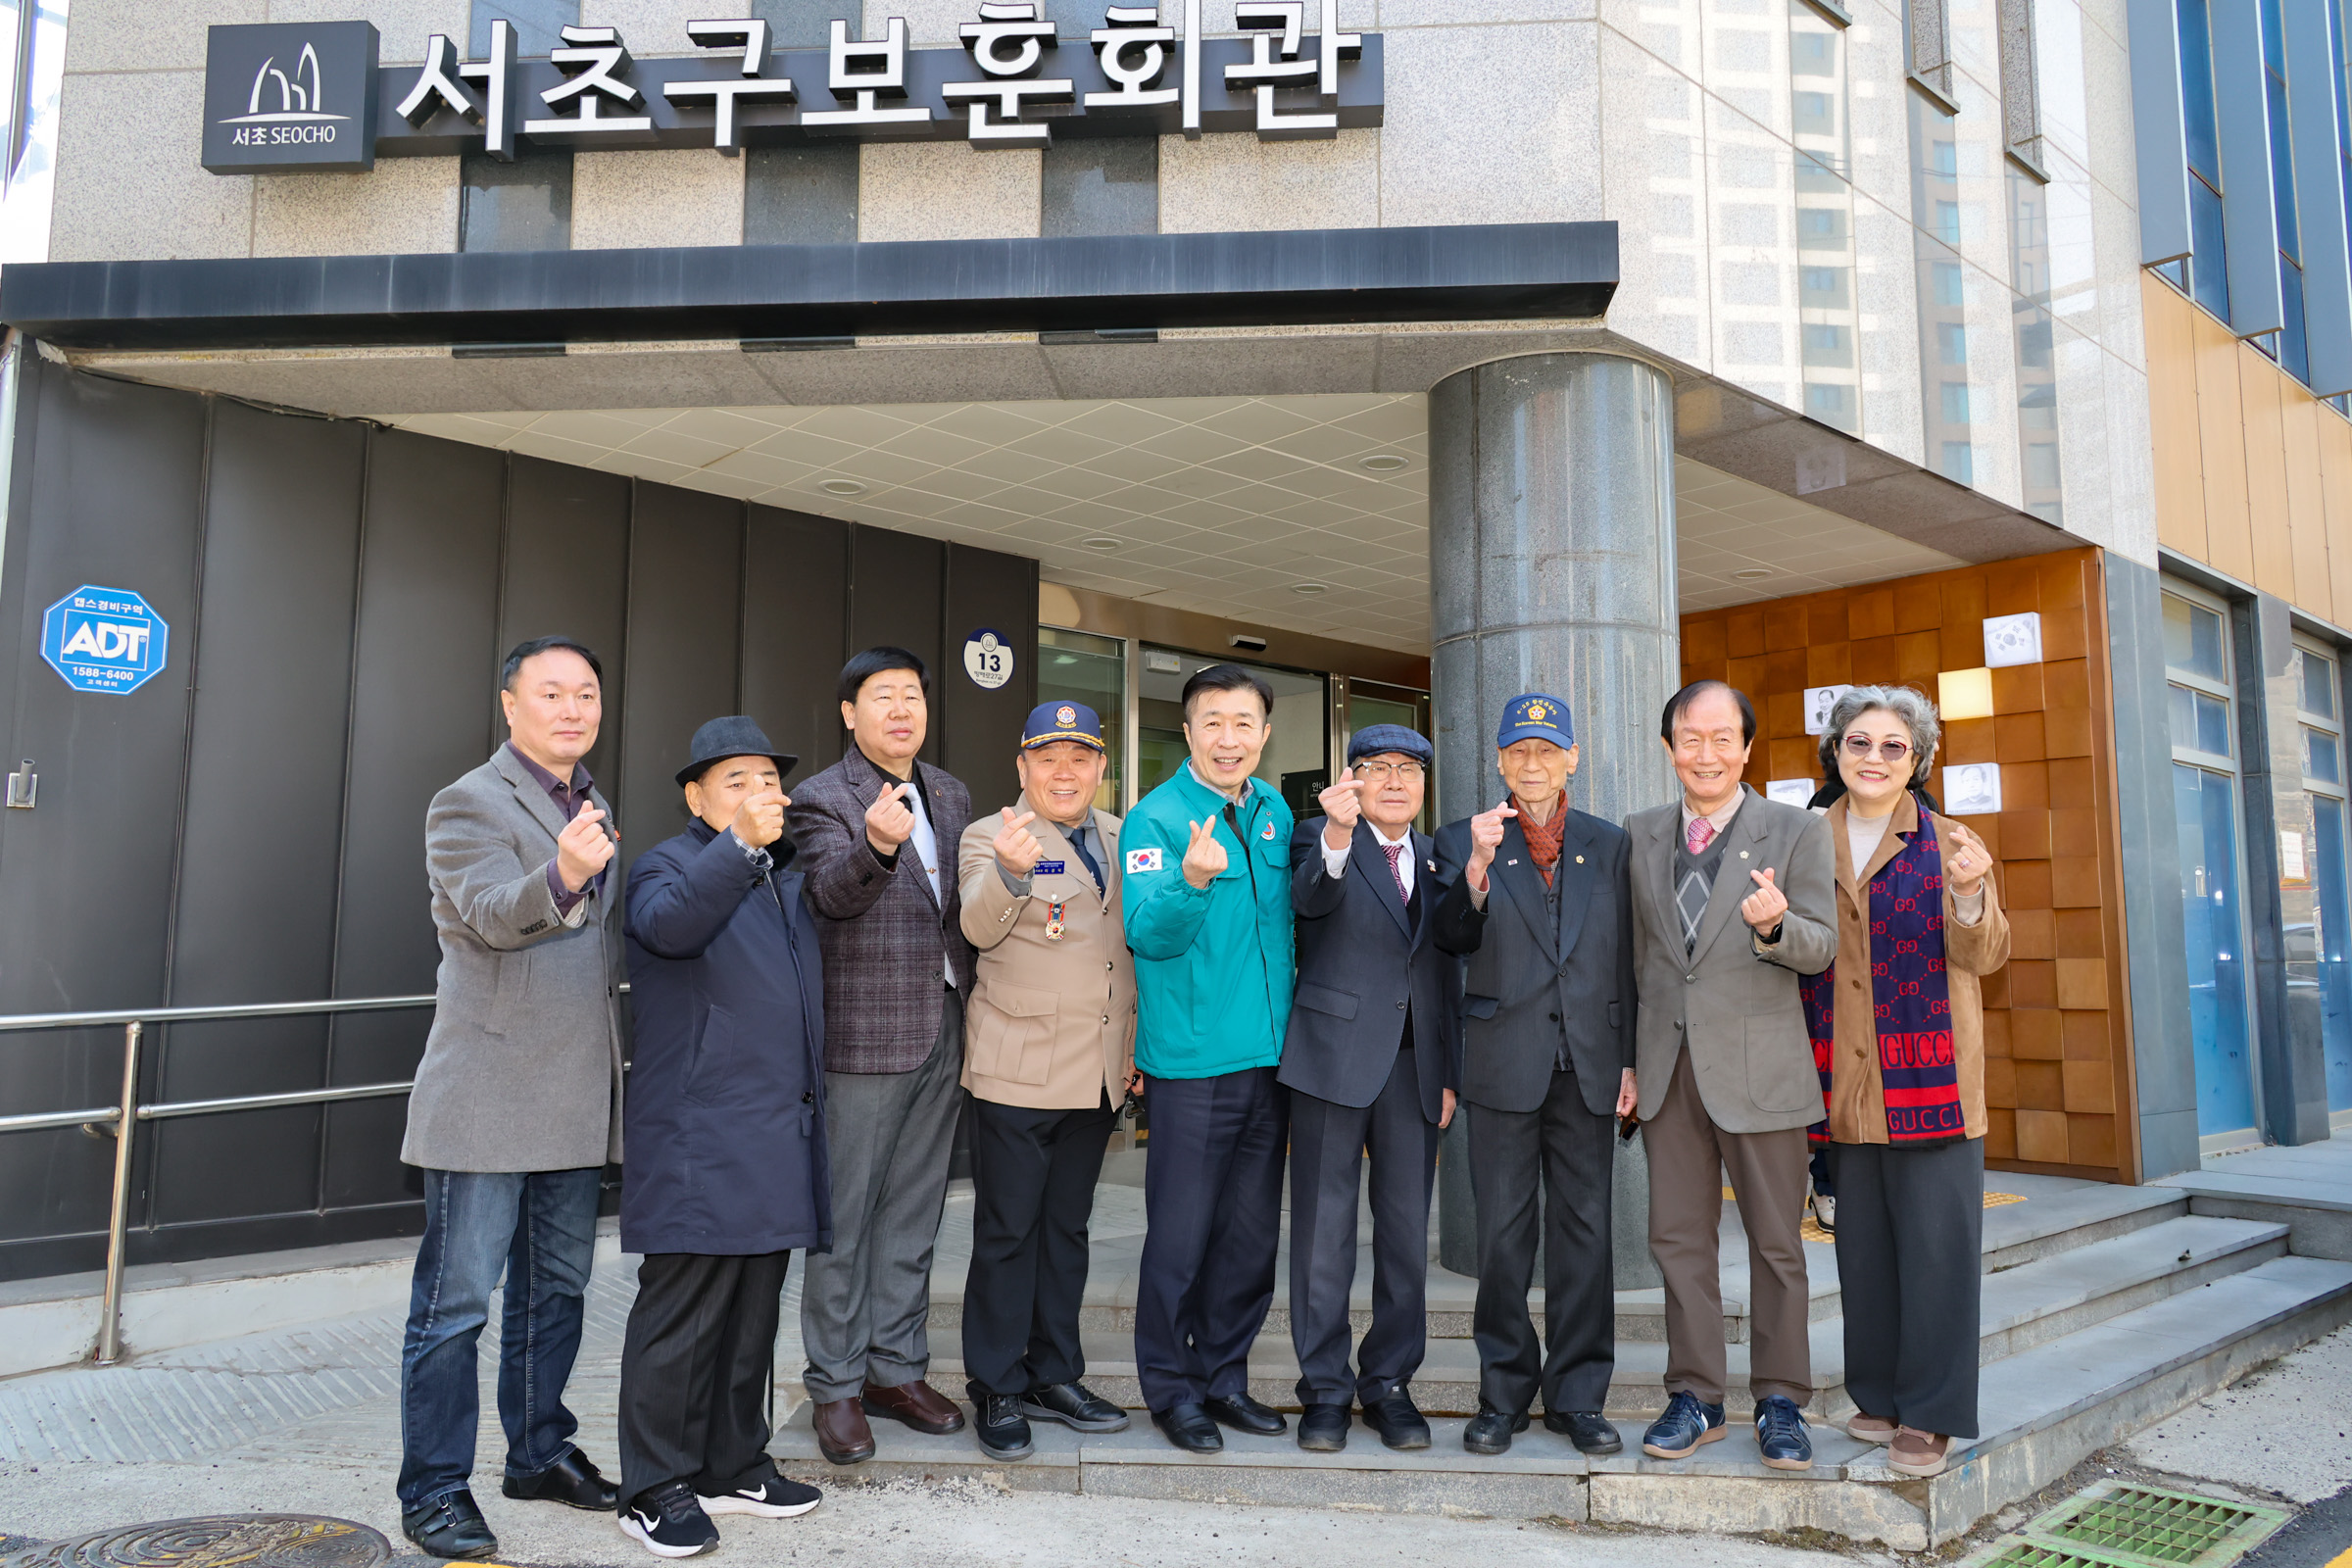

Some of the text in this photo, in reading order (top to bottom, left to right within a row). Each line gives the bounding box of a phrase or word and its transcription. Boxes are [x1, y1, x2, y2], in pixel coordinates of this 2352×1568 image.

[396, 2, 1361, 153] 서초구보훈회관
[232, 125, 336, 146] 서초 SEOCHO
[74, 597, 143, 615] 캡스경비구역
[63, 620, 149, 662] ADT
[979, 653, 1001, 672] 13
[73, 666, 134, 681] 1588-6400
[86, 678, 118, 687] 고객센터
[1883, 1031, 1956, 1068] GUCCI
[1887, 1104, 1962, 1131] GUCCI
